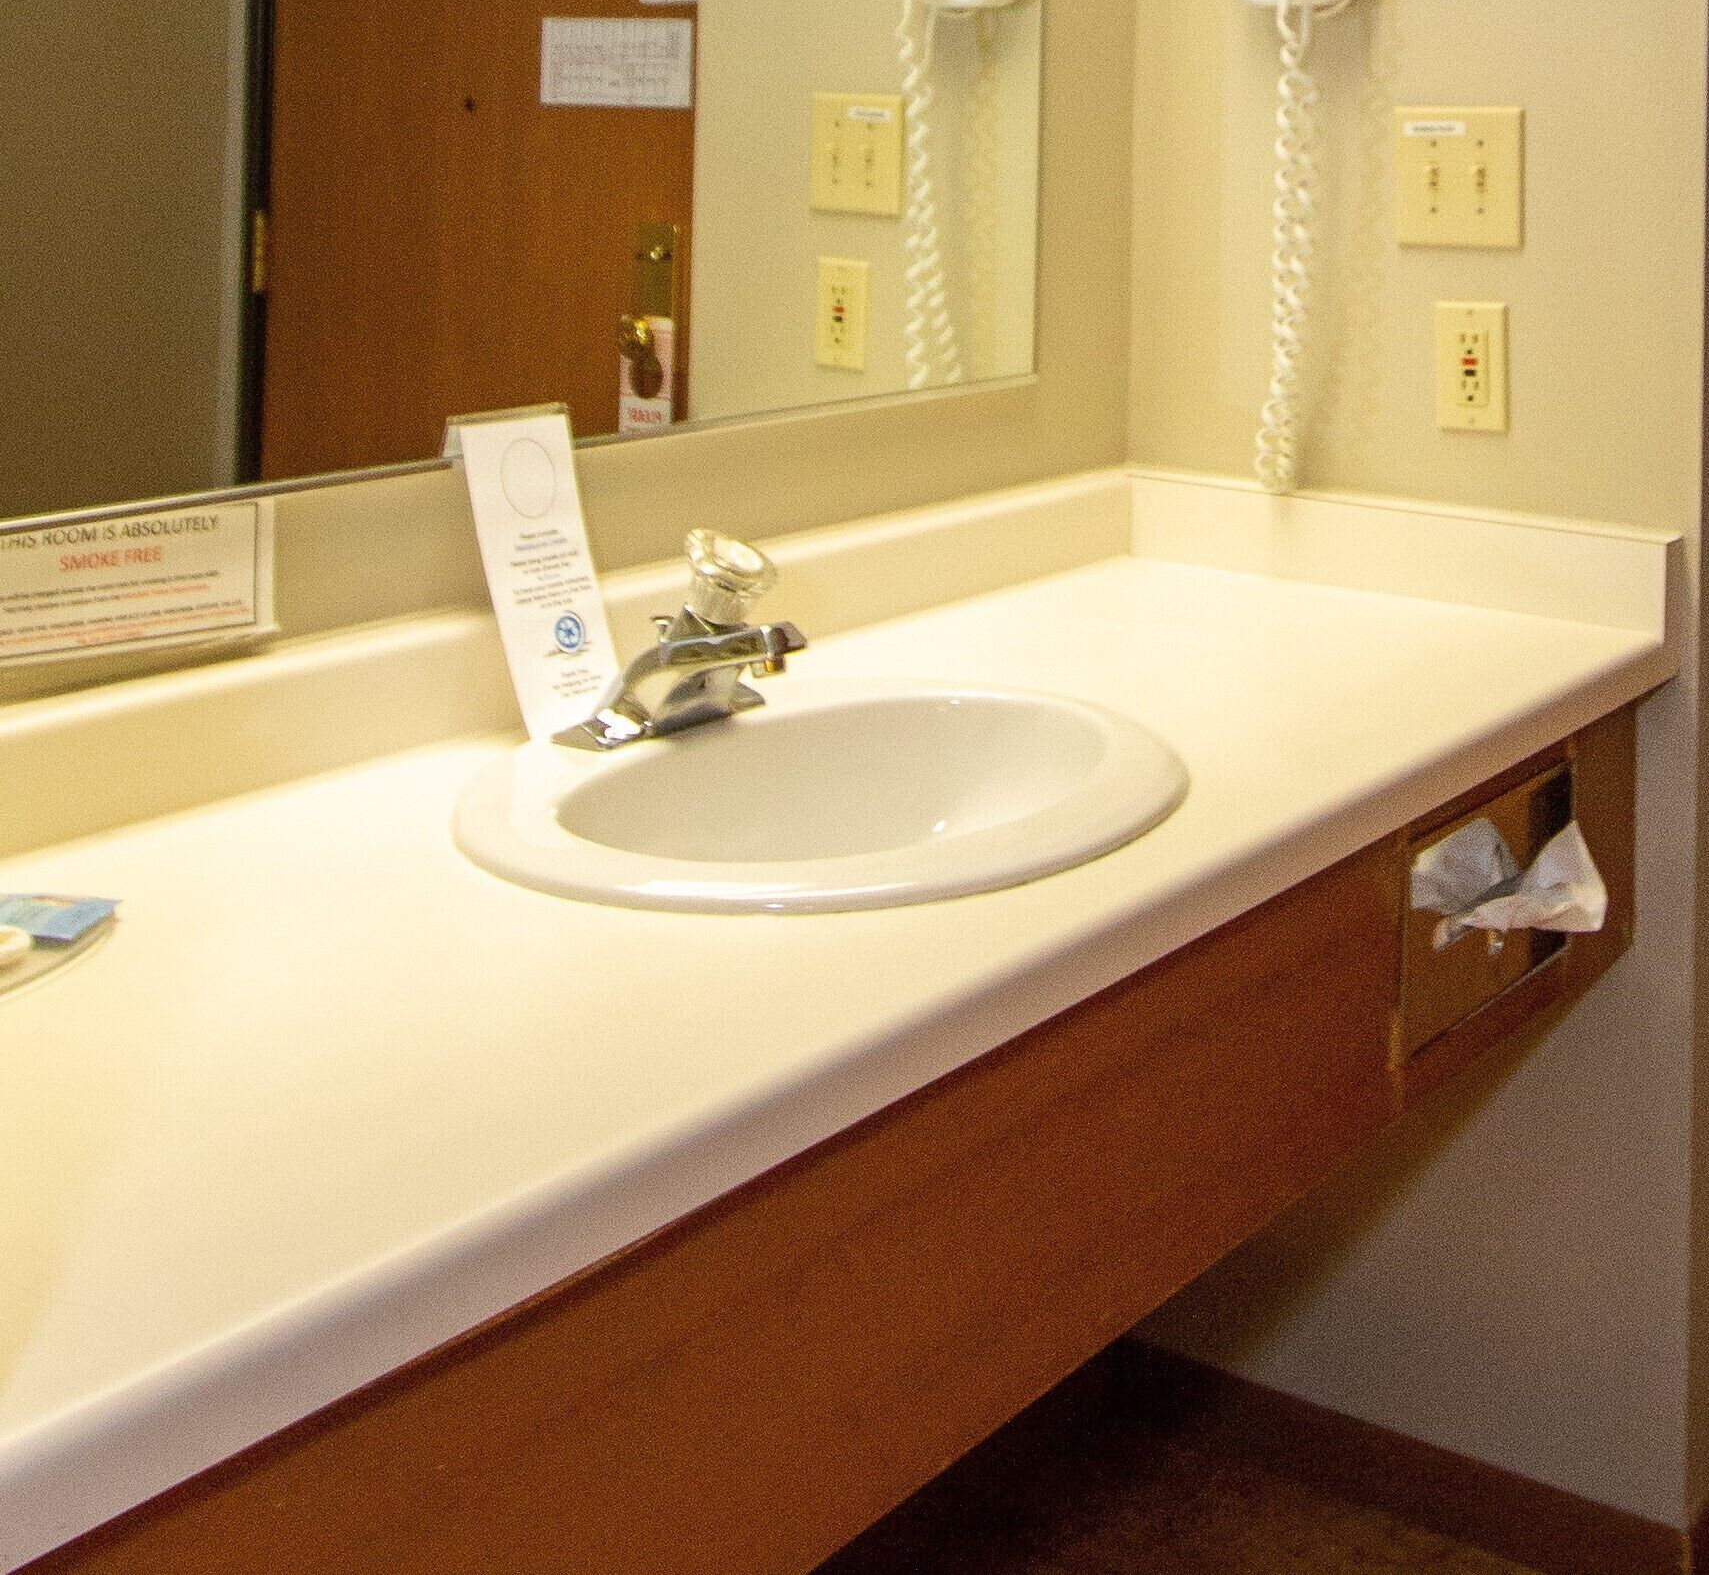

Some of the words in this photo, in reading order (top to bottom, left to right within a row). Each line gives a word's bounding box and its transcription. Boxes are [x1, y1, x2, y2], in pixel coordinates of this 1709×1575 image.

[42, 526, 97, 545] ROOM
[102, 524, 116, 541] IS
[121, 515, 219, 538] ABSOLUTELY
[60, 549, 118, 572] SMOKE
[124, 546, 161, 565] FREE
